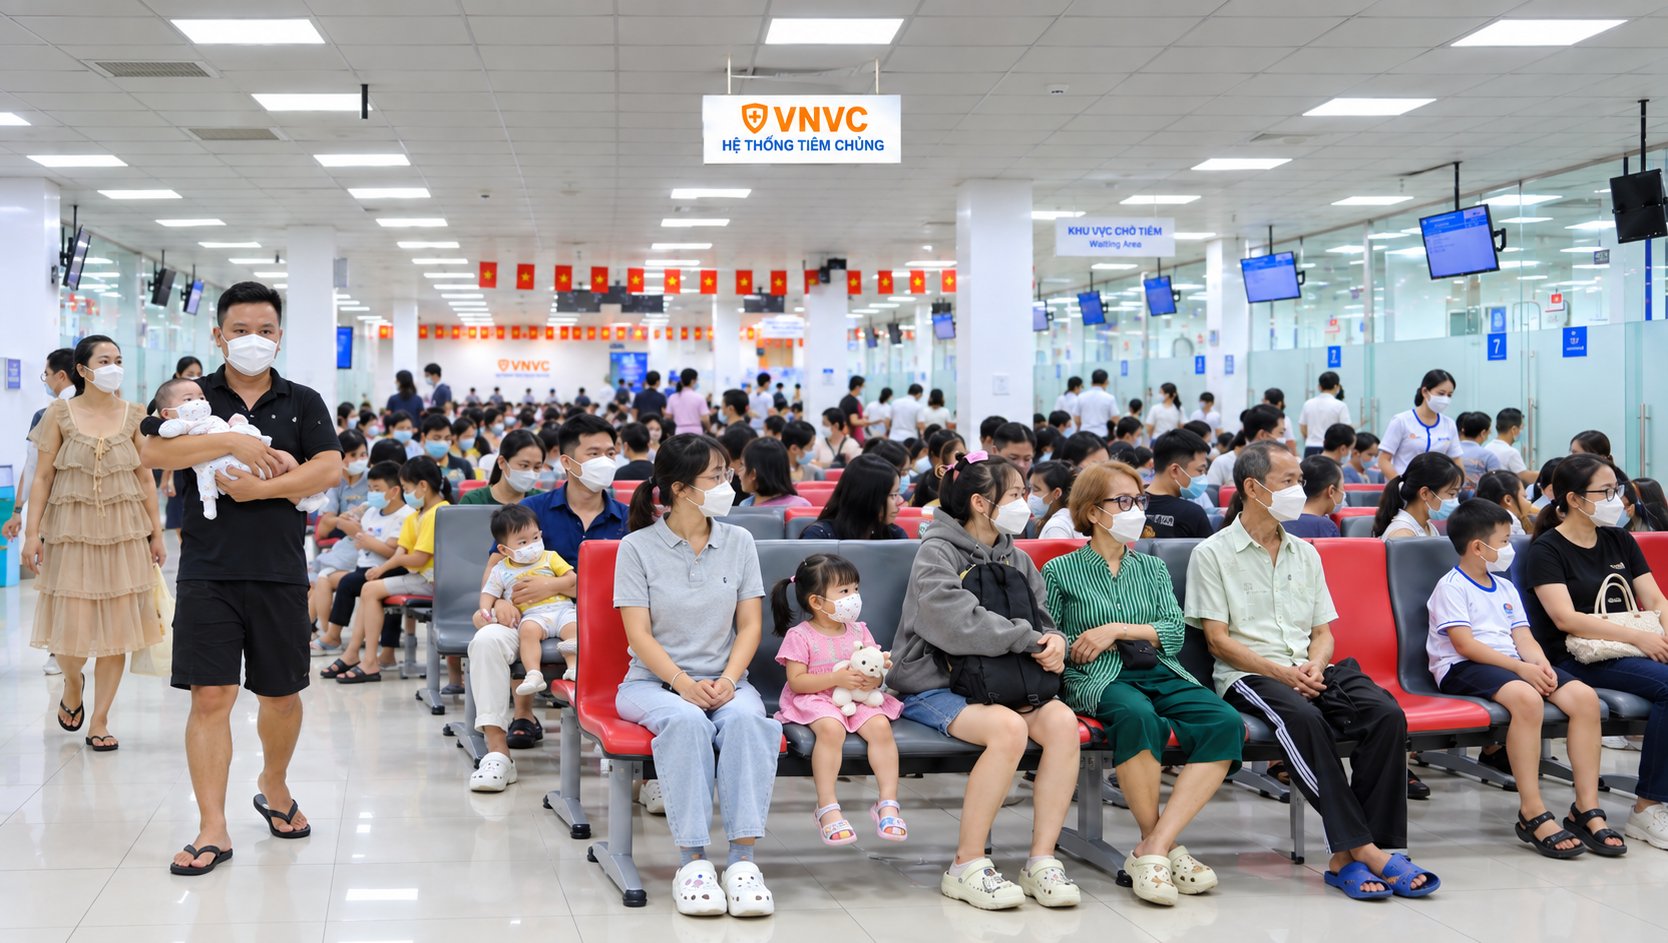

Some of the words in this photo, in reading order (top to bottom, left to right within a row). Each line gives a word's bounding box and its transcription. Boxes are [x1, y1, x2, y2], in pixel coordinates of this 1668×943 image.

[773, 106, 868, 133] VNVC
[722, 136, 741, 154] HỆ
[744, 134, 794, 152] THỐNG
[797, 136, 831, 151] TIÊM
[834, 135, 885, 151] CHỦNG
[1068, 226, 1090, 236] KHU
[1138, 225, 1163, 236] TIÊM
[1123, 240, 1142, 248] Area
[1493, 338, 1501, 354] 7
[511, 359, 550, 372] VNVC
